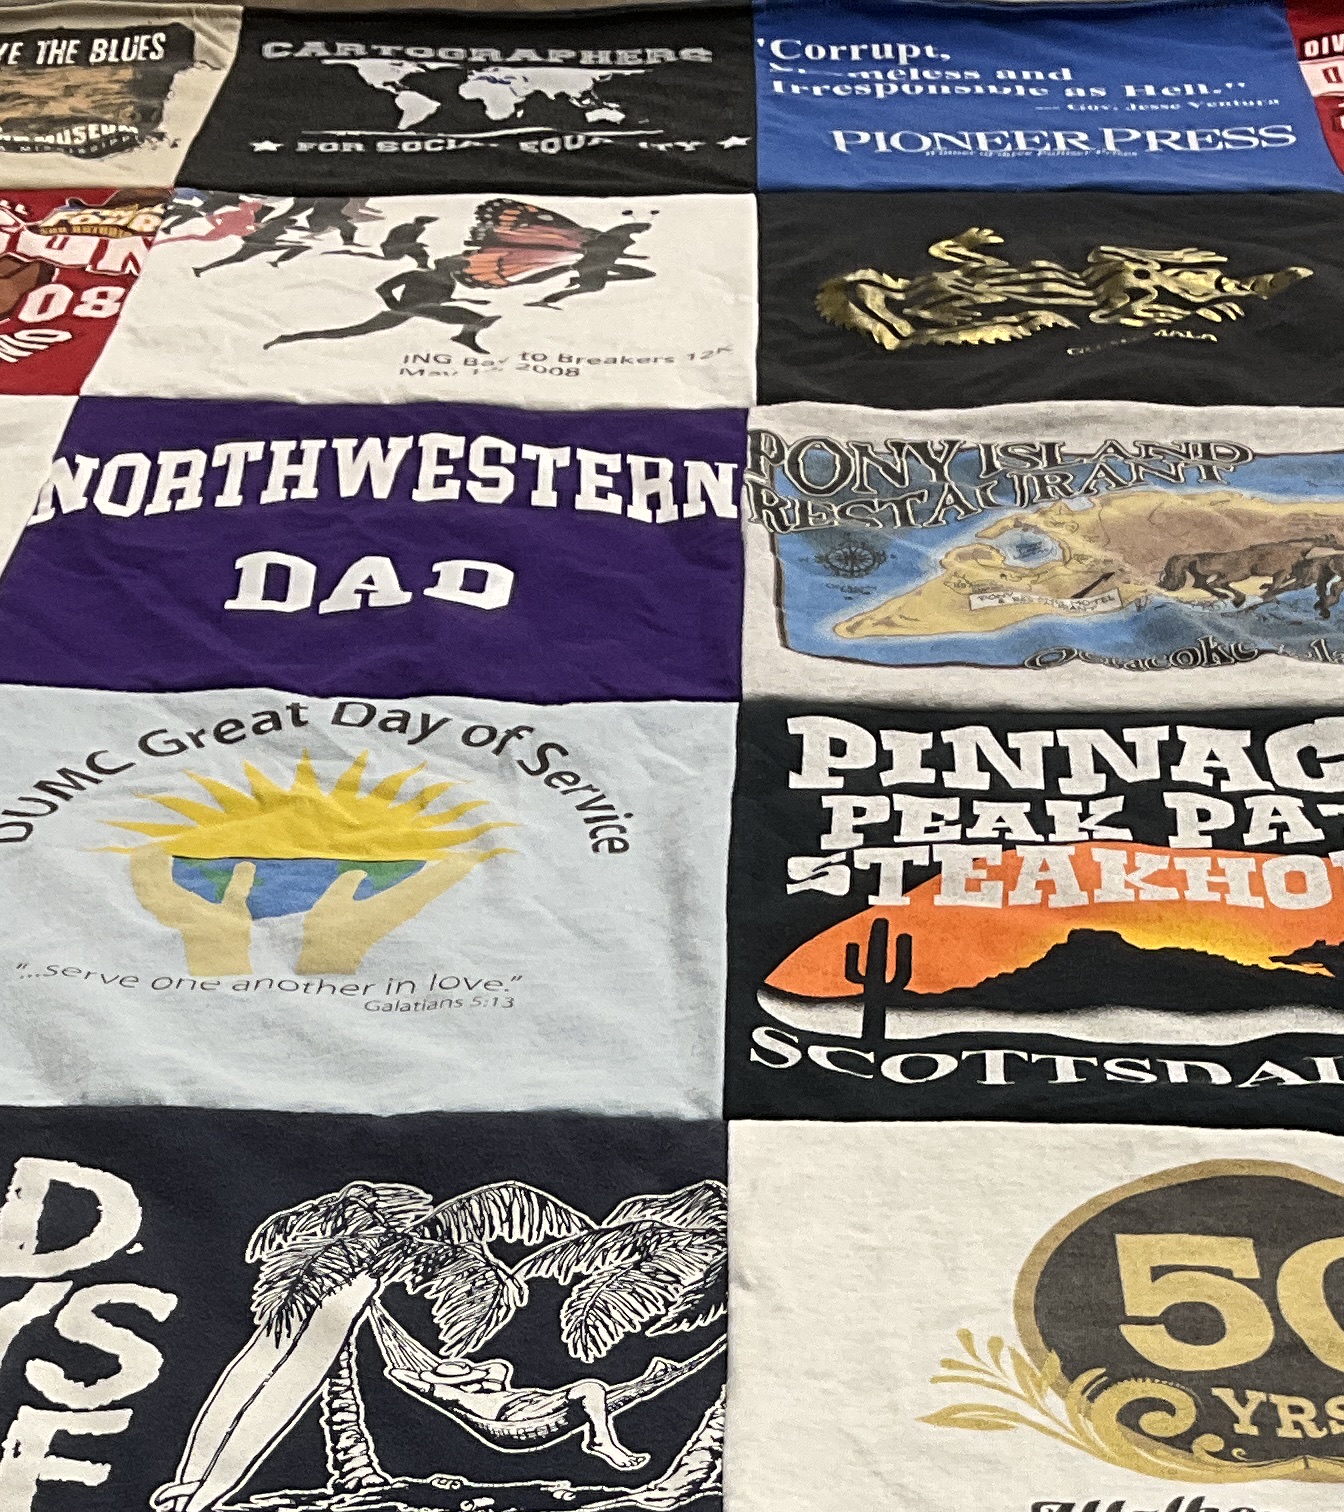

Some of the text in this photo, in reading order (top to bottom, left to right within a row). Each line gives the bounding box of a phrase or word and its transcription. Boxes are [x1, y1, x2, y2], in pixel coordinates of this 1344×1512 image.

[37, 39, 80, 64] THE
[89, 32, 166, 63] BLUES
[262, 40, 713, 65] CARTOGRAPHERS
[996, 67, 1073, 82] and
[1065, 86, 1106, 98] as
[296, 141, 364, 153] FOR
[830, 125, 1297, 154] PIONEER PRESS
[20, 285, 123, 324] 08
[402, 352, 452, 365] ING
[520, 350, 548, 362] to
[557, 351, 676, 366] Breakers
[515, 362, 581, 378] 2008
[747, 429, 1257, 498] PONY ISLAND
[27, 432, 739, 527] NORTHWESTERN
[745, 460, 1246, 534] RESTAURANT
[223, 551, 515, 615] DAD
[136, 700, 310, 760] Great
[330, 700, 455, 747] Day
[460, 722, 535, 759] of
[516, 739, 631, 858] Service
[818, 788, 1123, 851] PEAK
[152, 974, 224, 993] one
[230, 975, 376, 999] another
[384, 975, 418, 996] in
[363, 994, 517, 1014] Galatians 5:13
